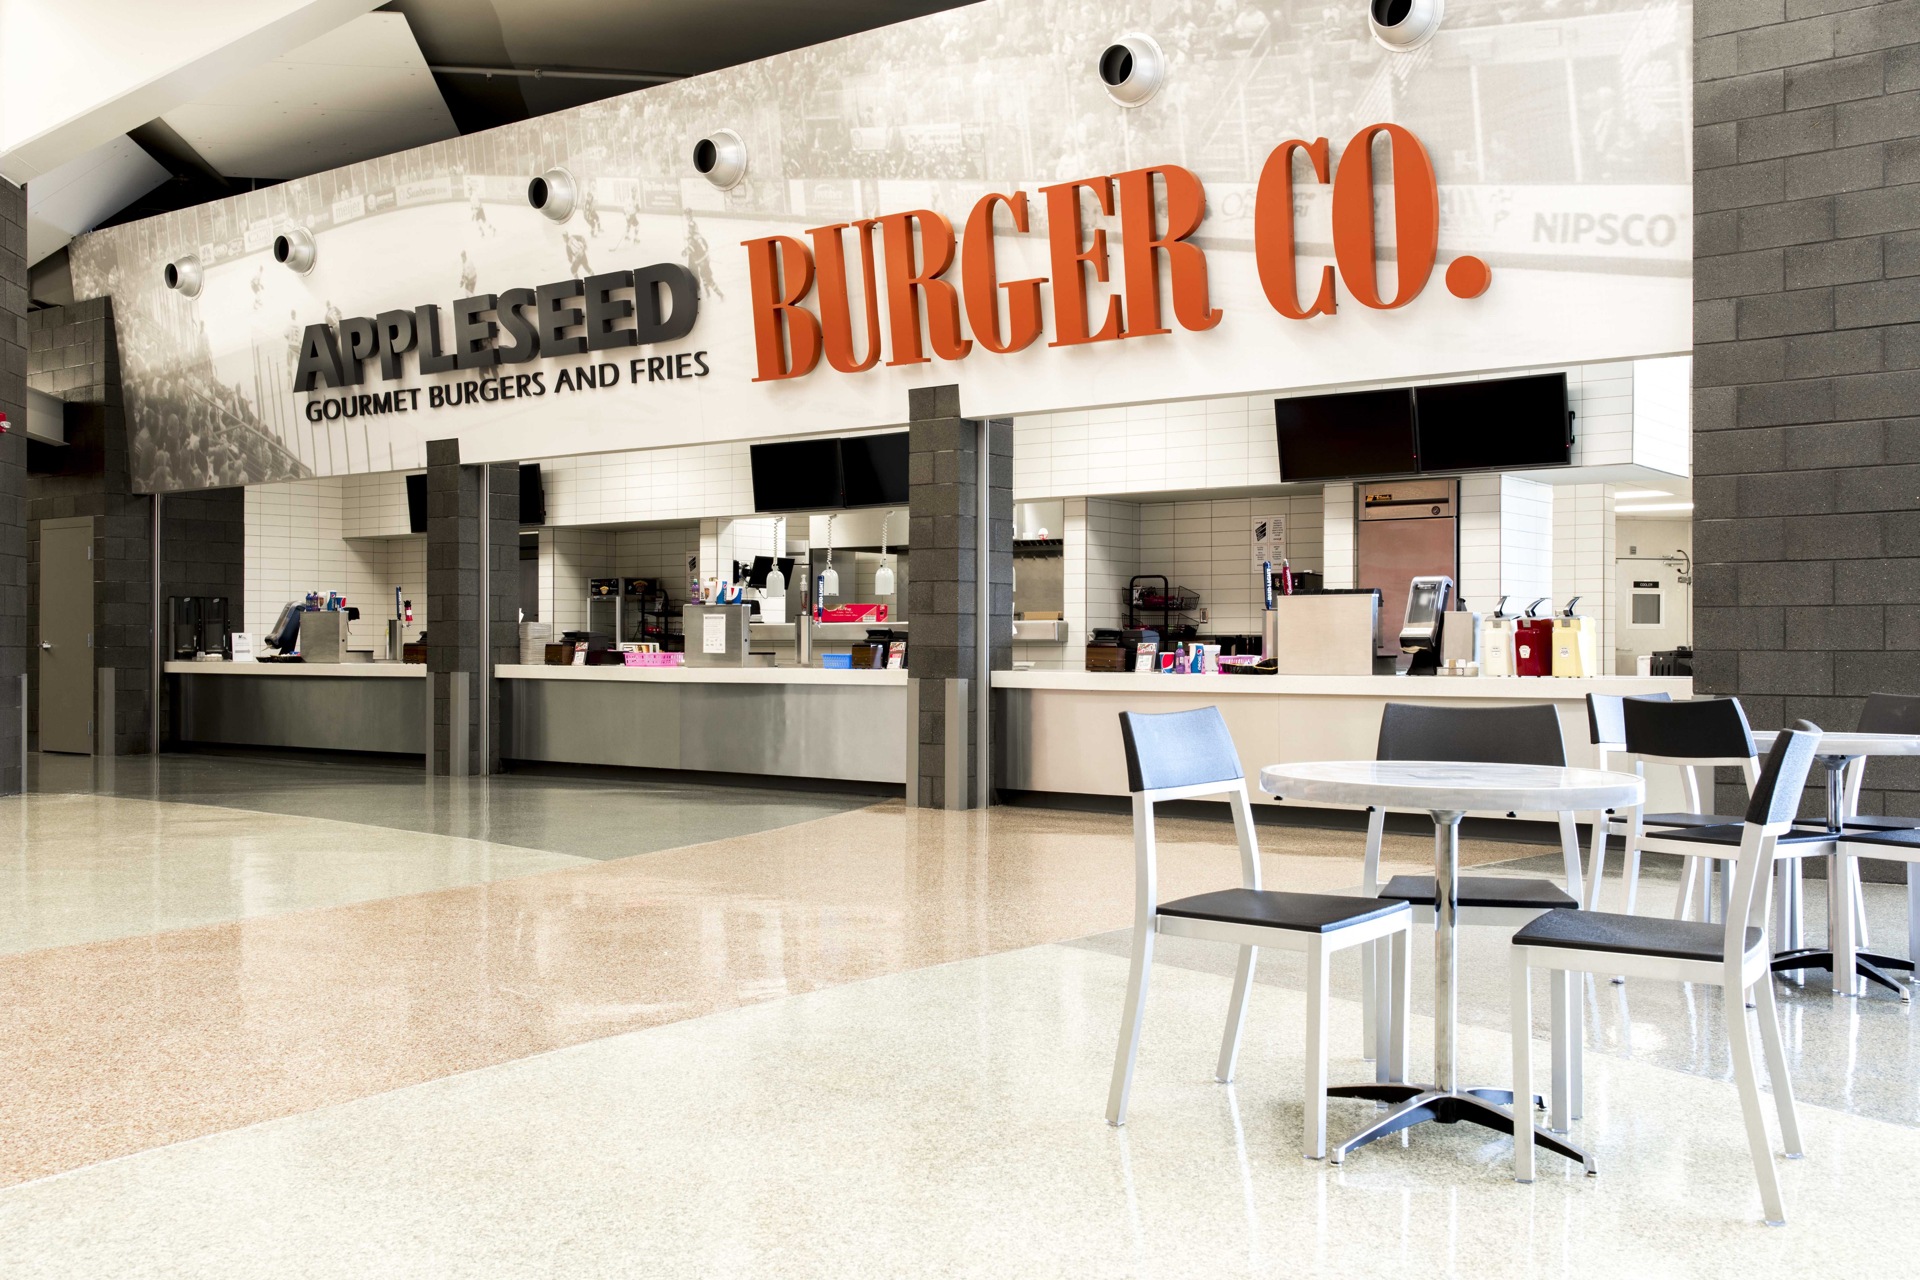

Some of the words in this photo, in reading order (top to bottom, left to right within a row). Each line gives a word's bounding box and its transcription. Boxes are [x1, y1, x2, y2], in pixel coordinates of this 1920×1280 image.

[740, 163, 1224, 383] BURGER
[1254, 122, 1492, 321] CO.
[1532, 211, 1676, 248] NIPSCO
[293, 262, 700, 393] APPLESEED
[305, 387, 422, 423] GOURMET
[428, 371, 547, 409] BURGERS
[554, 362, 620, 394] AND
[630, 351, 710, 385] FRIES
